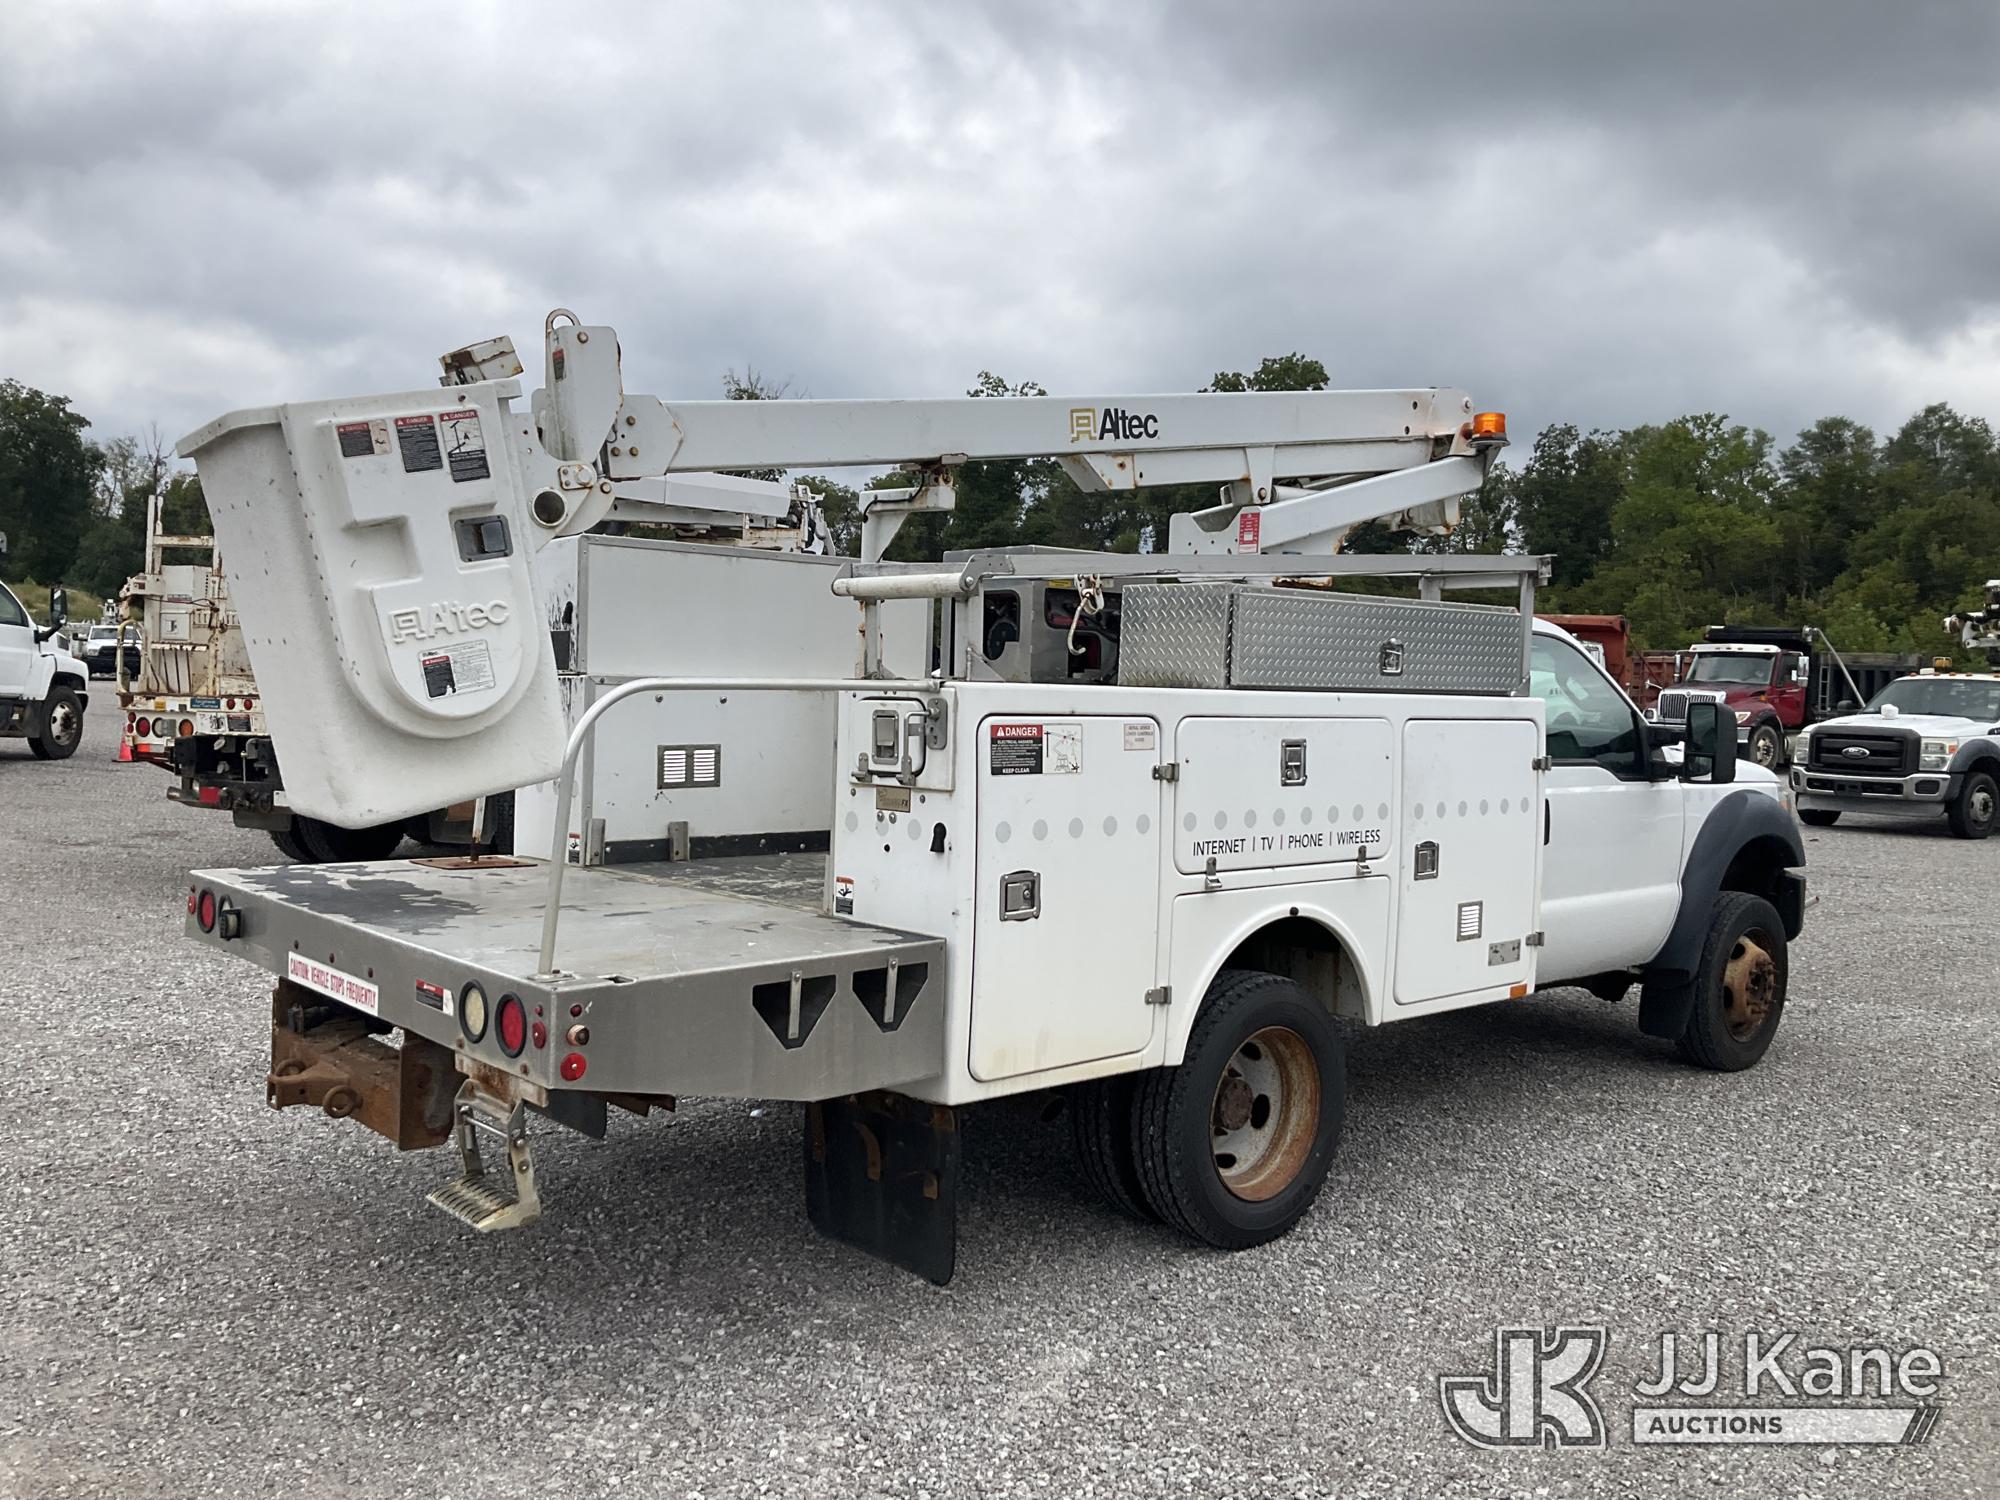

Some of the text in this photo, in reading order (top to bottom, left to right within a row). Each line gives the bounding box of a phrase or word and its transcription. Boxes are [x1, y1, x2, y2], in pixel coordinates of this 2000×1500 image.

[1098, 407, 1159, 441] Altec
[427, 600, 510, 640] Altec
[1005, 727, 1038, 736] DANGER
[1193, 838, 1247, 856] INTERNET
[1261, 836, 1274, 851] TV
[1287, 833, 1323, 849] PHONE
[1336, 829, 1381, 845] WIRELESS
[311, 965, 330, 989] VEHICLE
[331, 974, 345, 995] STOPS
[346, 981, 376, 1008] FREQUENTLY
